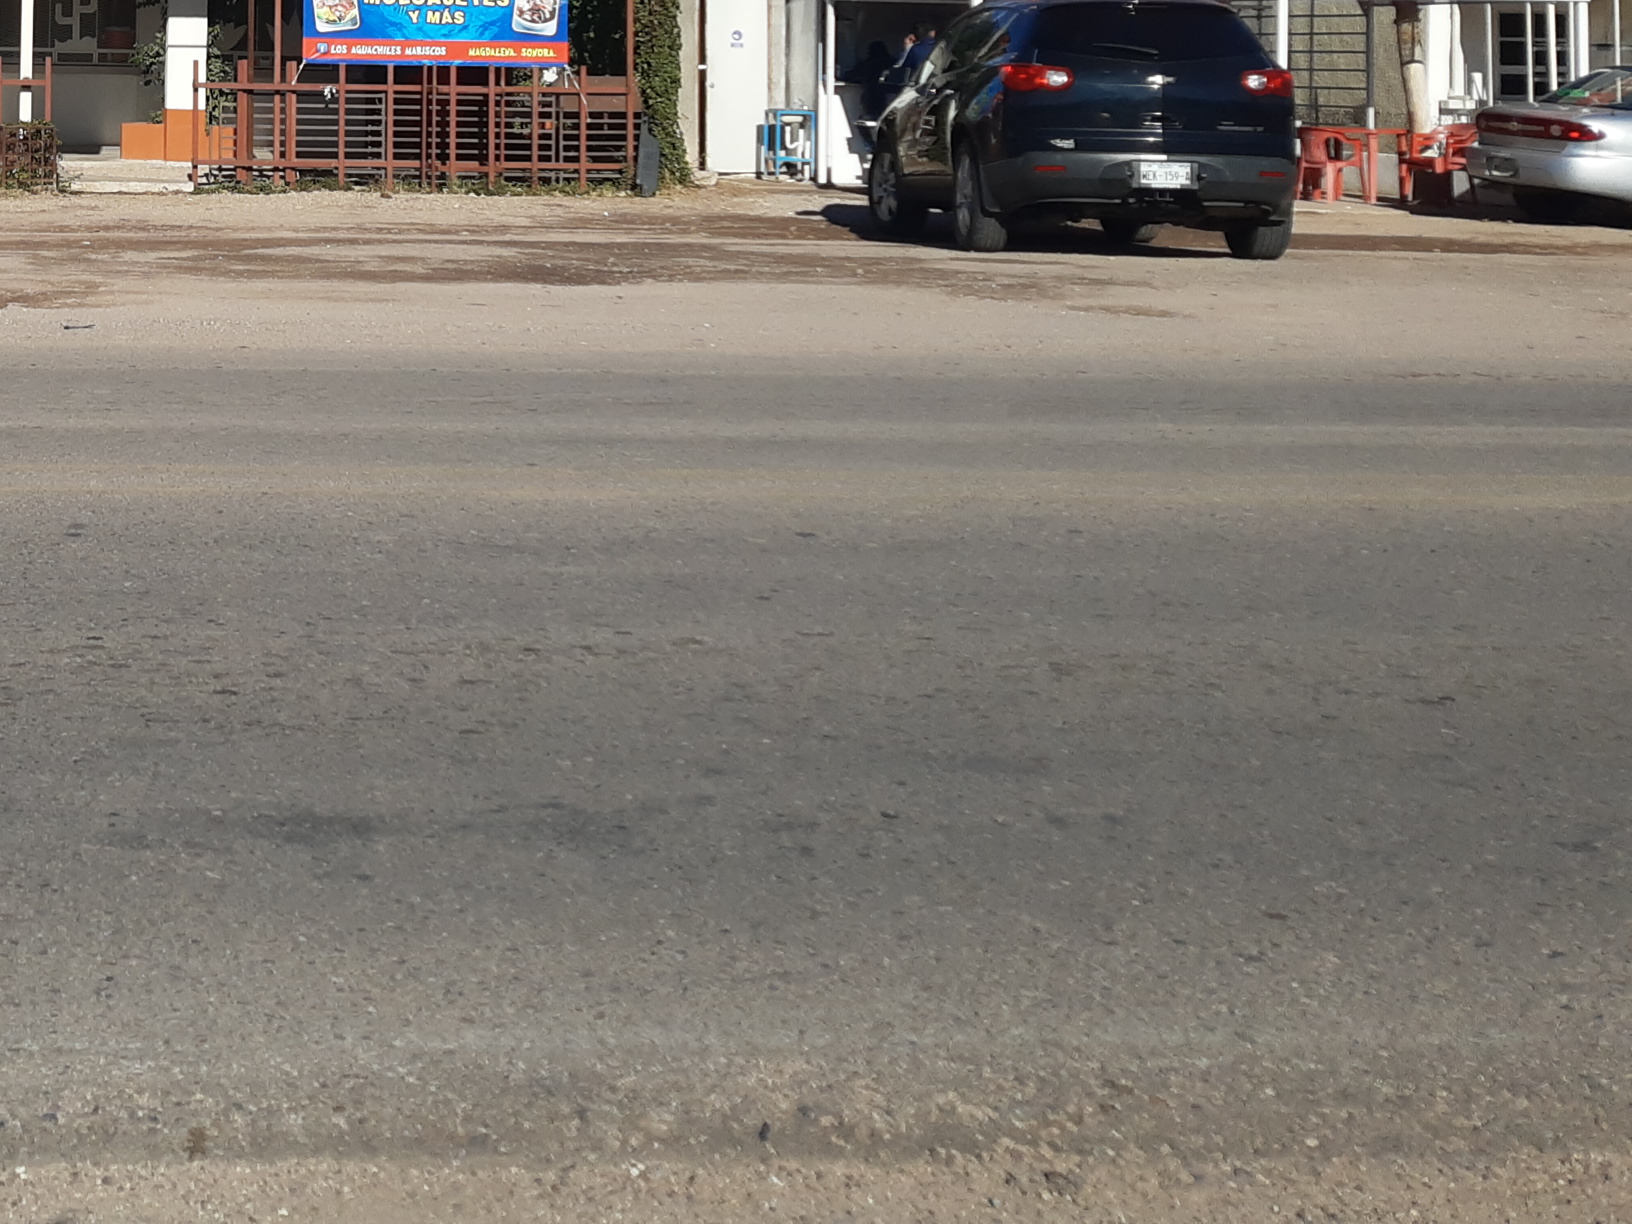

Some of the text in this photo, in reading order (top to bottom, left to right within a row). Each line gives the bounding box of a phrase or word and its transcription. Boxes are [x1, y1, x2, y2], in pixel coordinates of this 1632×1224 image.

[408, 8, 465, 25] Y MÁS
[330, 44, 447, 56] LOS AGUACHILES MARISCOS
